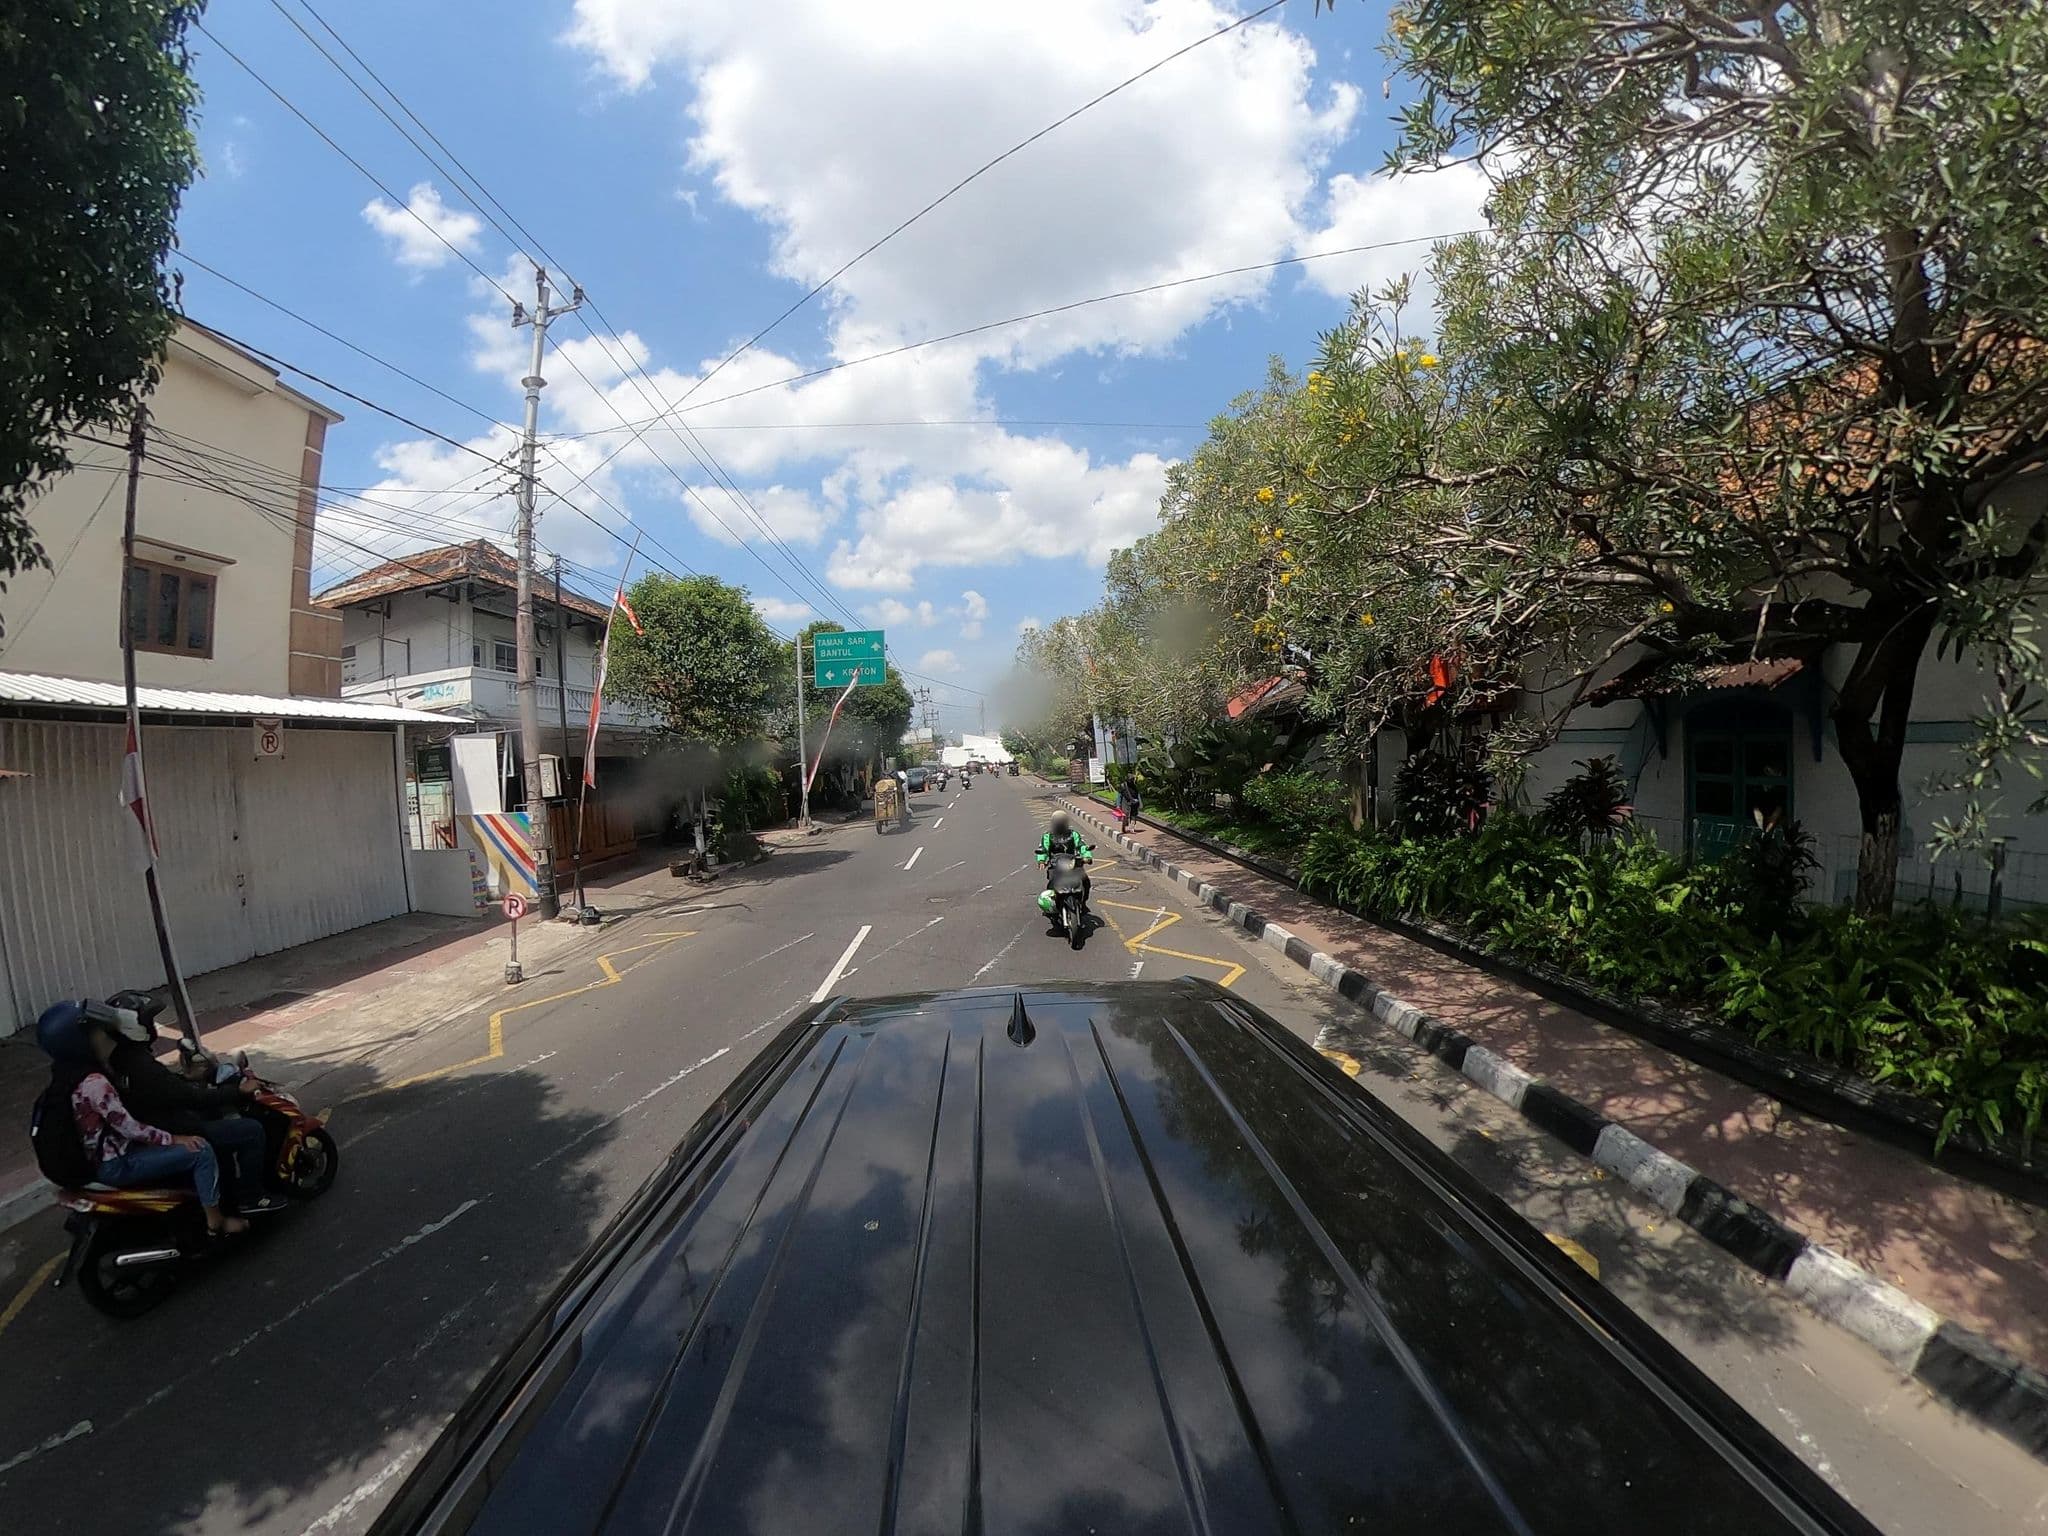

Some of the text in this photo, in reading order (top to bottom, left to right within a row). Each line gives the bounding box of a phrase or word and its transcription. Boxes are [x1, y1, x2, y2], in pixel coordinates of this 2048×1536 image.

[817, 637, 866, 646] TAMAN SARI
[820, 649, 853, 657] BANTUL
[842, 667, 876, 676] KRTON
